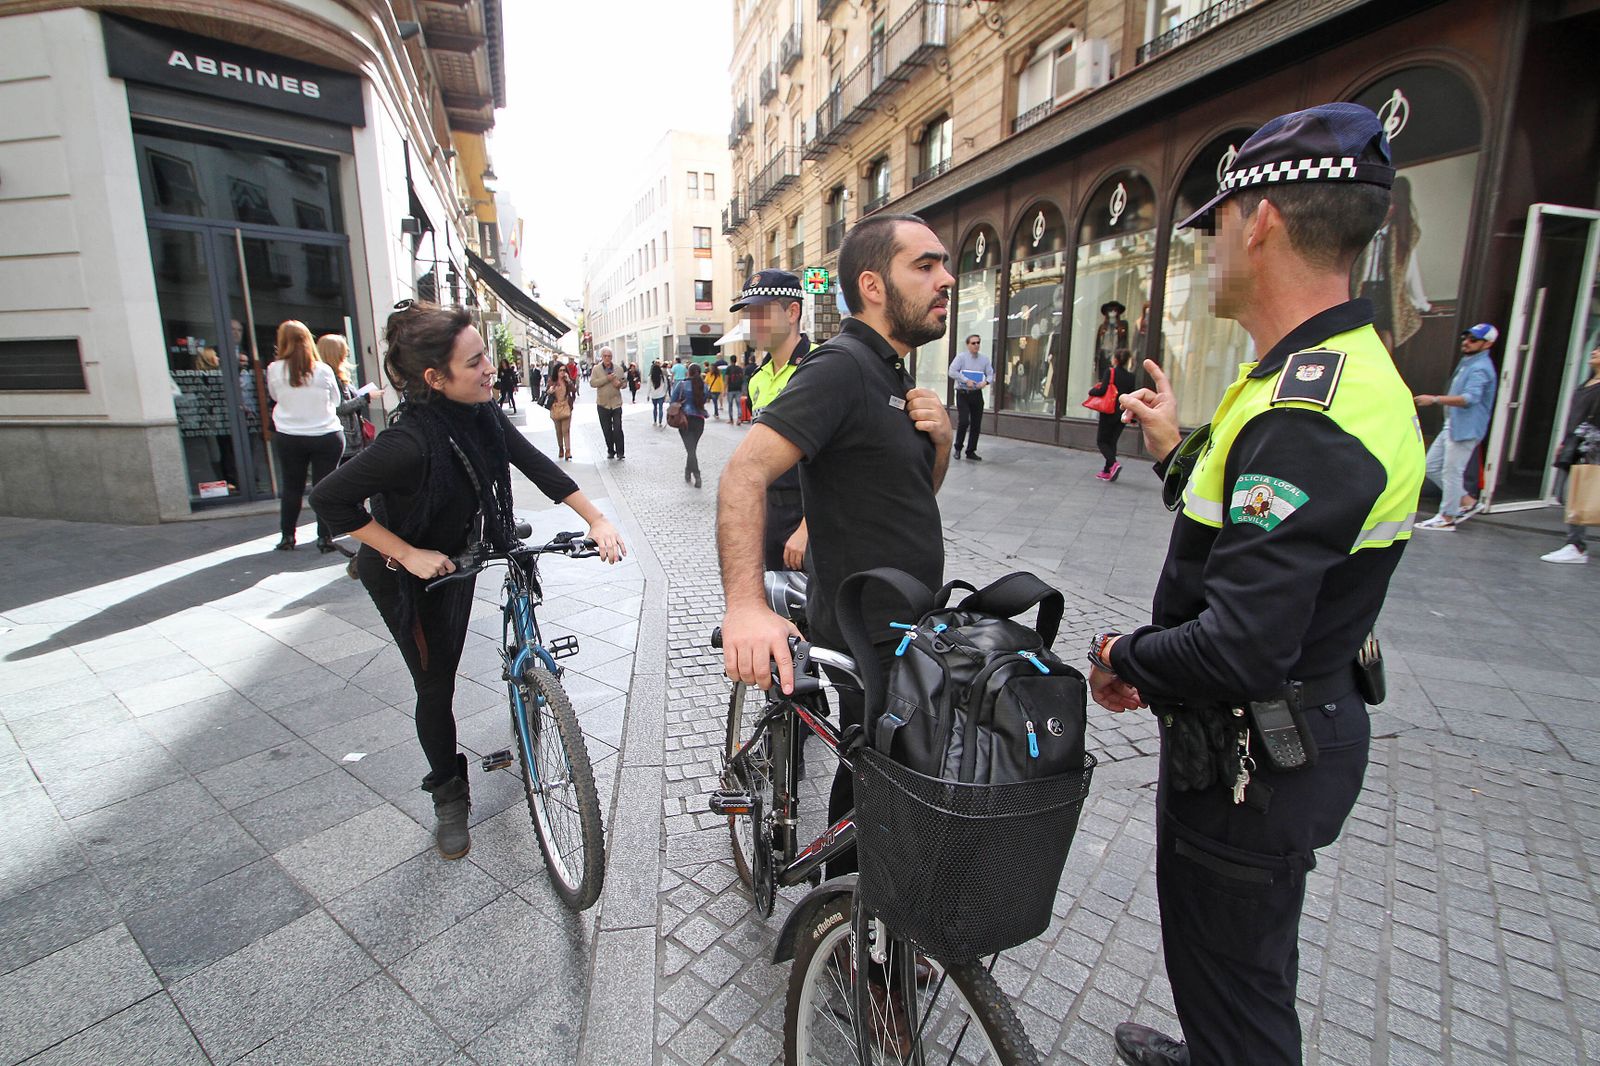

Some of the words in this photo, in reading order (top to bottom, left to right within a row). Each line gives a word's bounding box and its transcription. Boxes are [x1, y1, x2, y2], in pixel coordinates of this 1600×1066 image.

[168, 50, 321, 99] ABRINES
[1237, 475, 1271, 484] OLICIA
[1273, 479, 1301, 497] LOCAL
[1237, 515, 1271, 529] SEVILLA
[817, 911, 844, 935] Rubena
